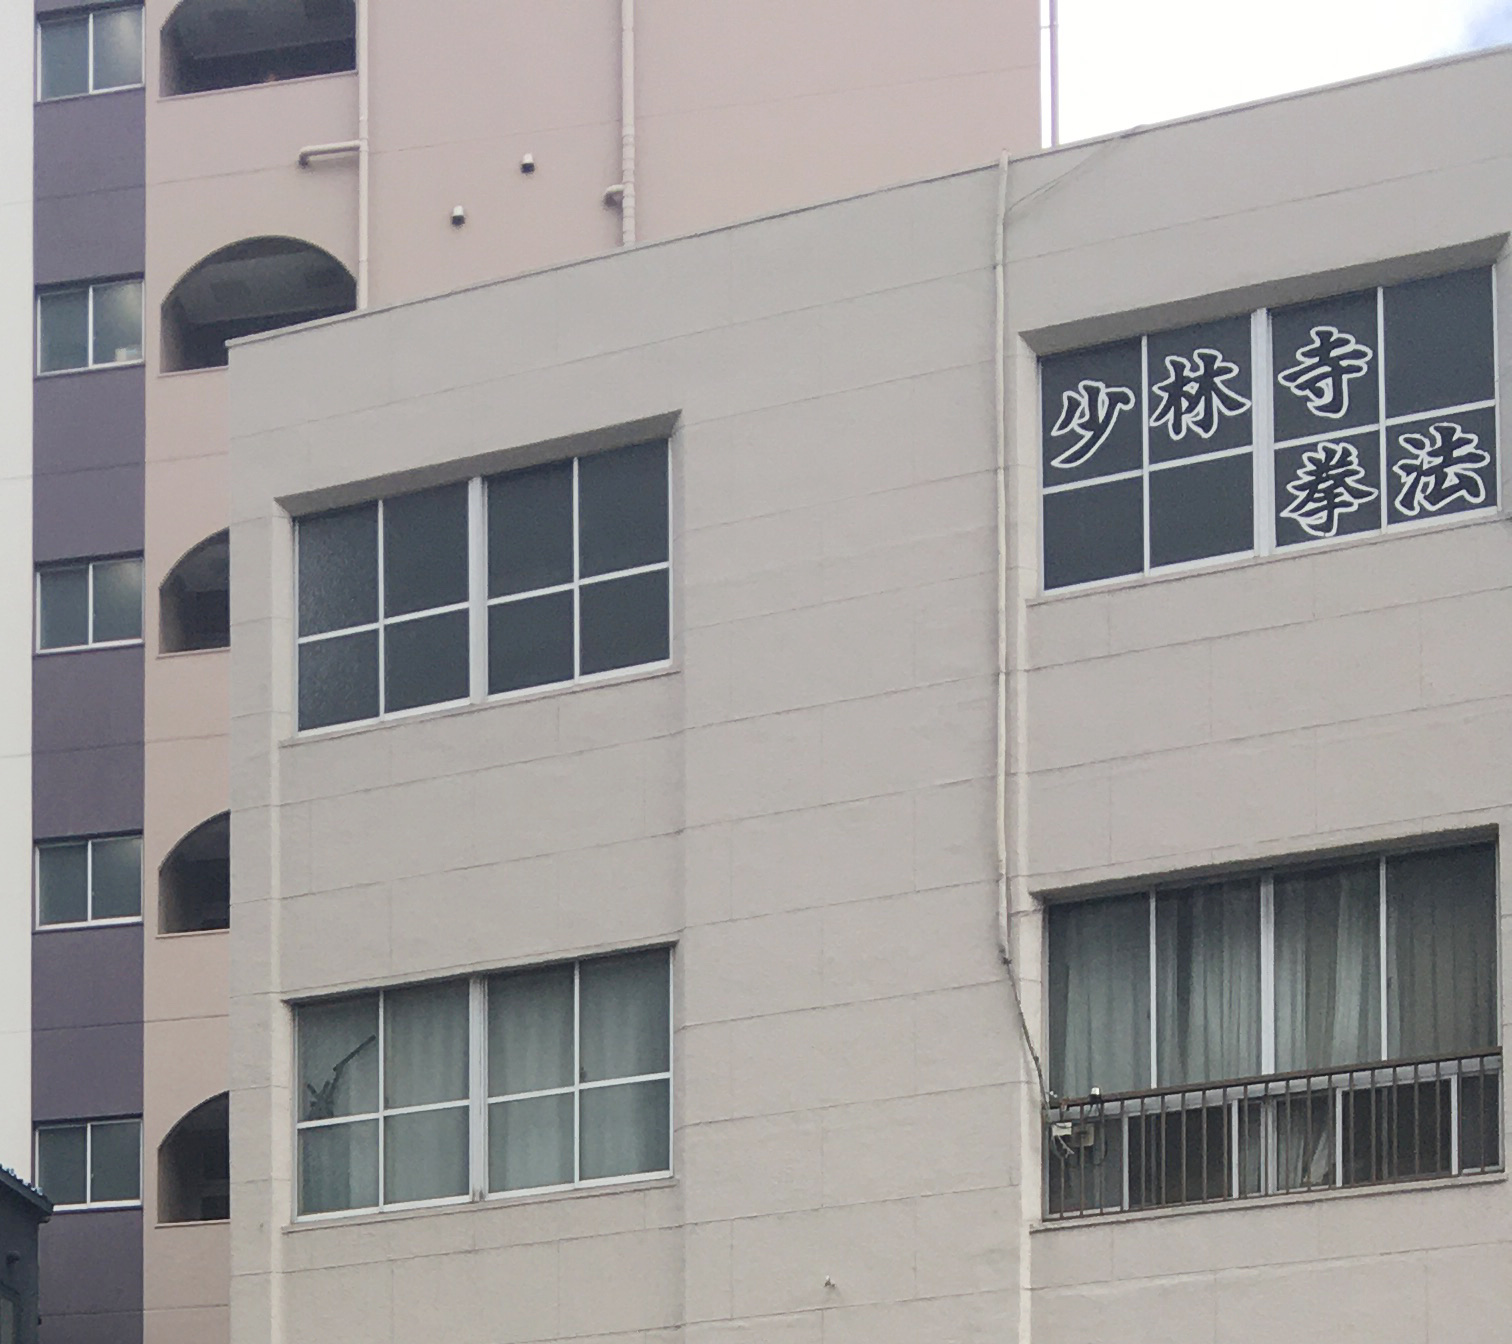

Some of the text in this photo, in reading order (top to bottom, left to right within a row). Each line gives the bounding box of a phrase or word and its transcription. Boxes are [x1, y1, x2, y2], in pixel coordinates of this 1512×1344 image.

[1051, 326, 1373, 467] 少林寺
[1280, 422, 1490, 537] 拳法
